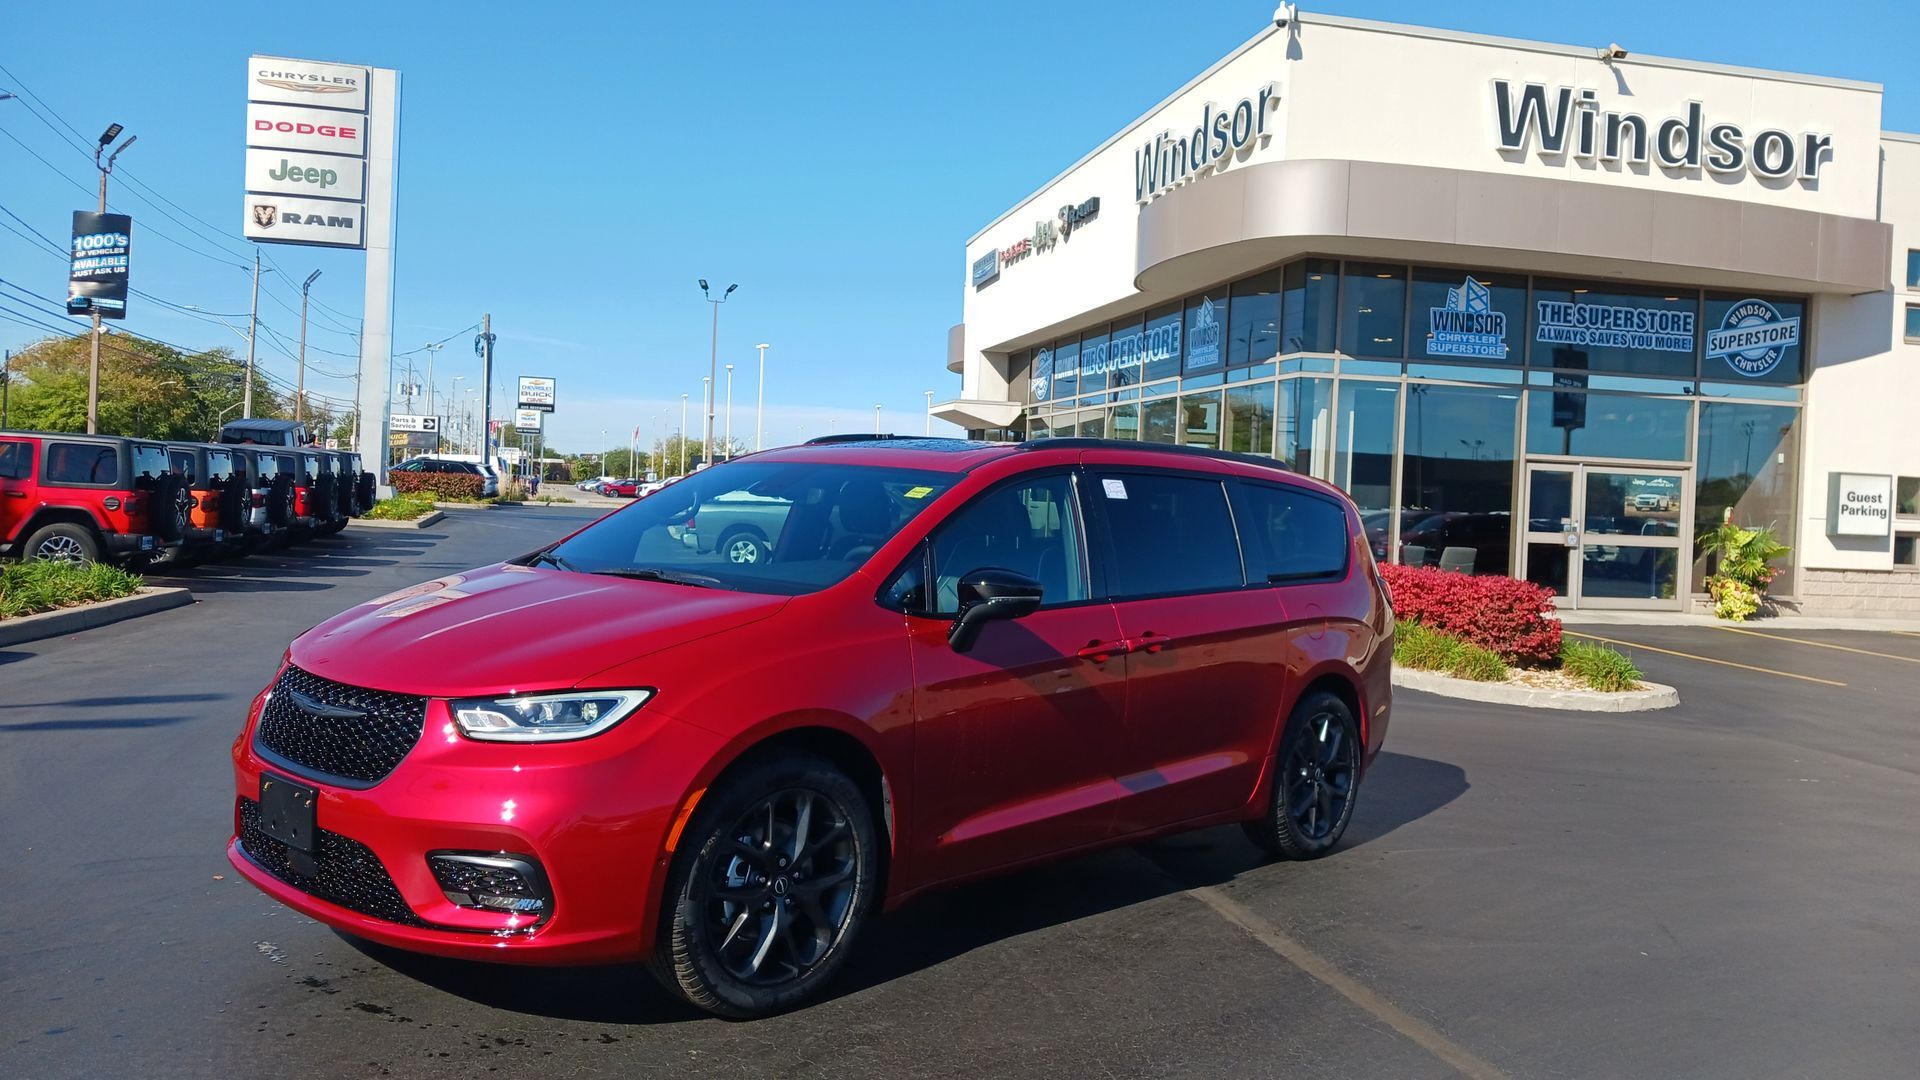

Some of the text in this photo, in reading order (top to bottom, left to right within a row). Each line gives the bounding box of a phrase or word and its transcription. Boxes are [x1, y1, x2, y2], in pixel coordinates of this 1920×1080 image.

[258, 70, 357, 86] CHRYSLER
[255, 119, 357, 139] DODGE
[1490, 78, 1833, 180] Windsor
[1135, 80, 1281, 205] Windsor
[269, 159, 338, 189] Jeep
[281, 212, 354, 229] RAM
[73, 234, 128, 250] 1000's
[76, 248, 125, 258] OF VEHICLES
[74, 256, 126, 269] AVAILABLE
[73, 269, 93, 278] JUST
[94, 267, 112, 275] ASK
[1433, 310, 1503, 335] WINDSOR
[1539, 302, 1694, 334] THE SUPERSTORE
[1729, 304, 1772, 326] WINDSOR
[1438, 333, 1496, 344] CHRYSLER
[1538, 326, 1692, 351] ALWAYS SAVES YOU MORE!
[1710, 325, 1796, 351] SUPERSTORE
[1096, 321, 1181, 374] SUPERSTORE
[1430, 342, 1504, 355] SUPERSTORE
[1735, 349, 1778, 372] CHRYSLER
[391, 416, 409, 424] Parts
[1847, 491, 1883, 503] Guest
[1841, 504, 1887, 519] Parking
